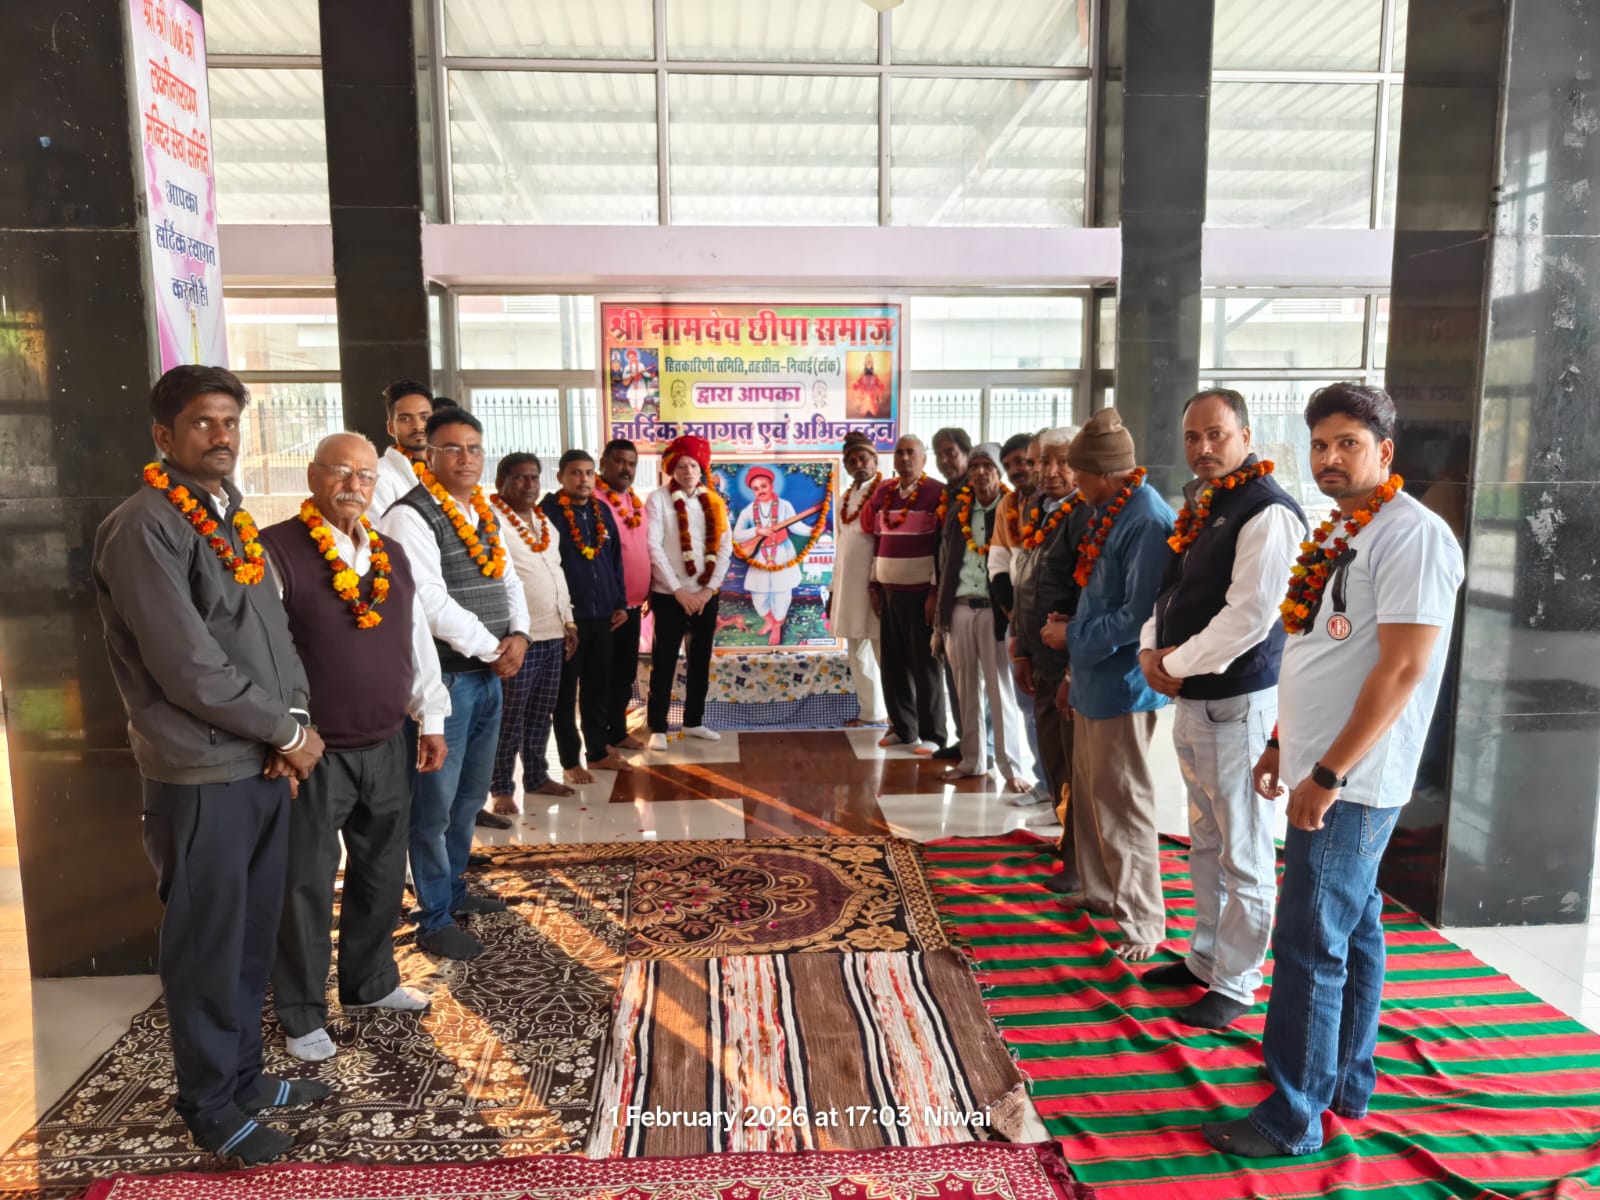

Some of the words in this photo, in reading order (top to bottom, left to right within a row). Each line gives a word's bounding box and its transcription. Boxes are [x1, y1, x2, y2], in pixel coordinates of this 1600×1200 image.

[166, 180, 199, 215] आपका
[187, 236, 216, 266] स्वागत
[171, 274, 199, 305] करती
[609, 308, 645, 344] श्री
[650, 310, 743, 344] नामदेव
[747, 310, 811, 345] छीपा
[814, 315, 896, 346] समाज
[665, 356, 714, 373] हितकारिणी
[696, 386, 734, 404] द्वारा
[738, 386, 801, 403] आपका
[610, 413, 678, 443] हार्दिक
[682, 421, 754, 441] स्वागत
[757, 413, 788, 444] एवं
